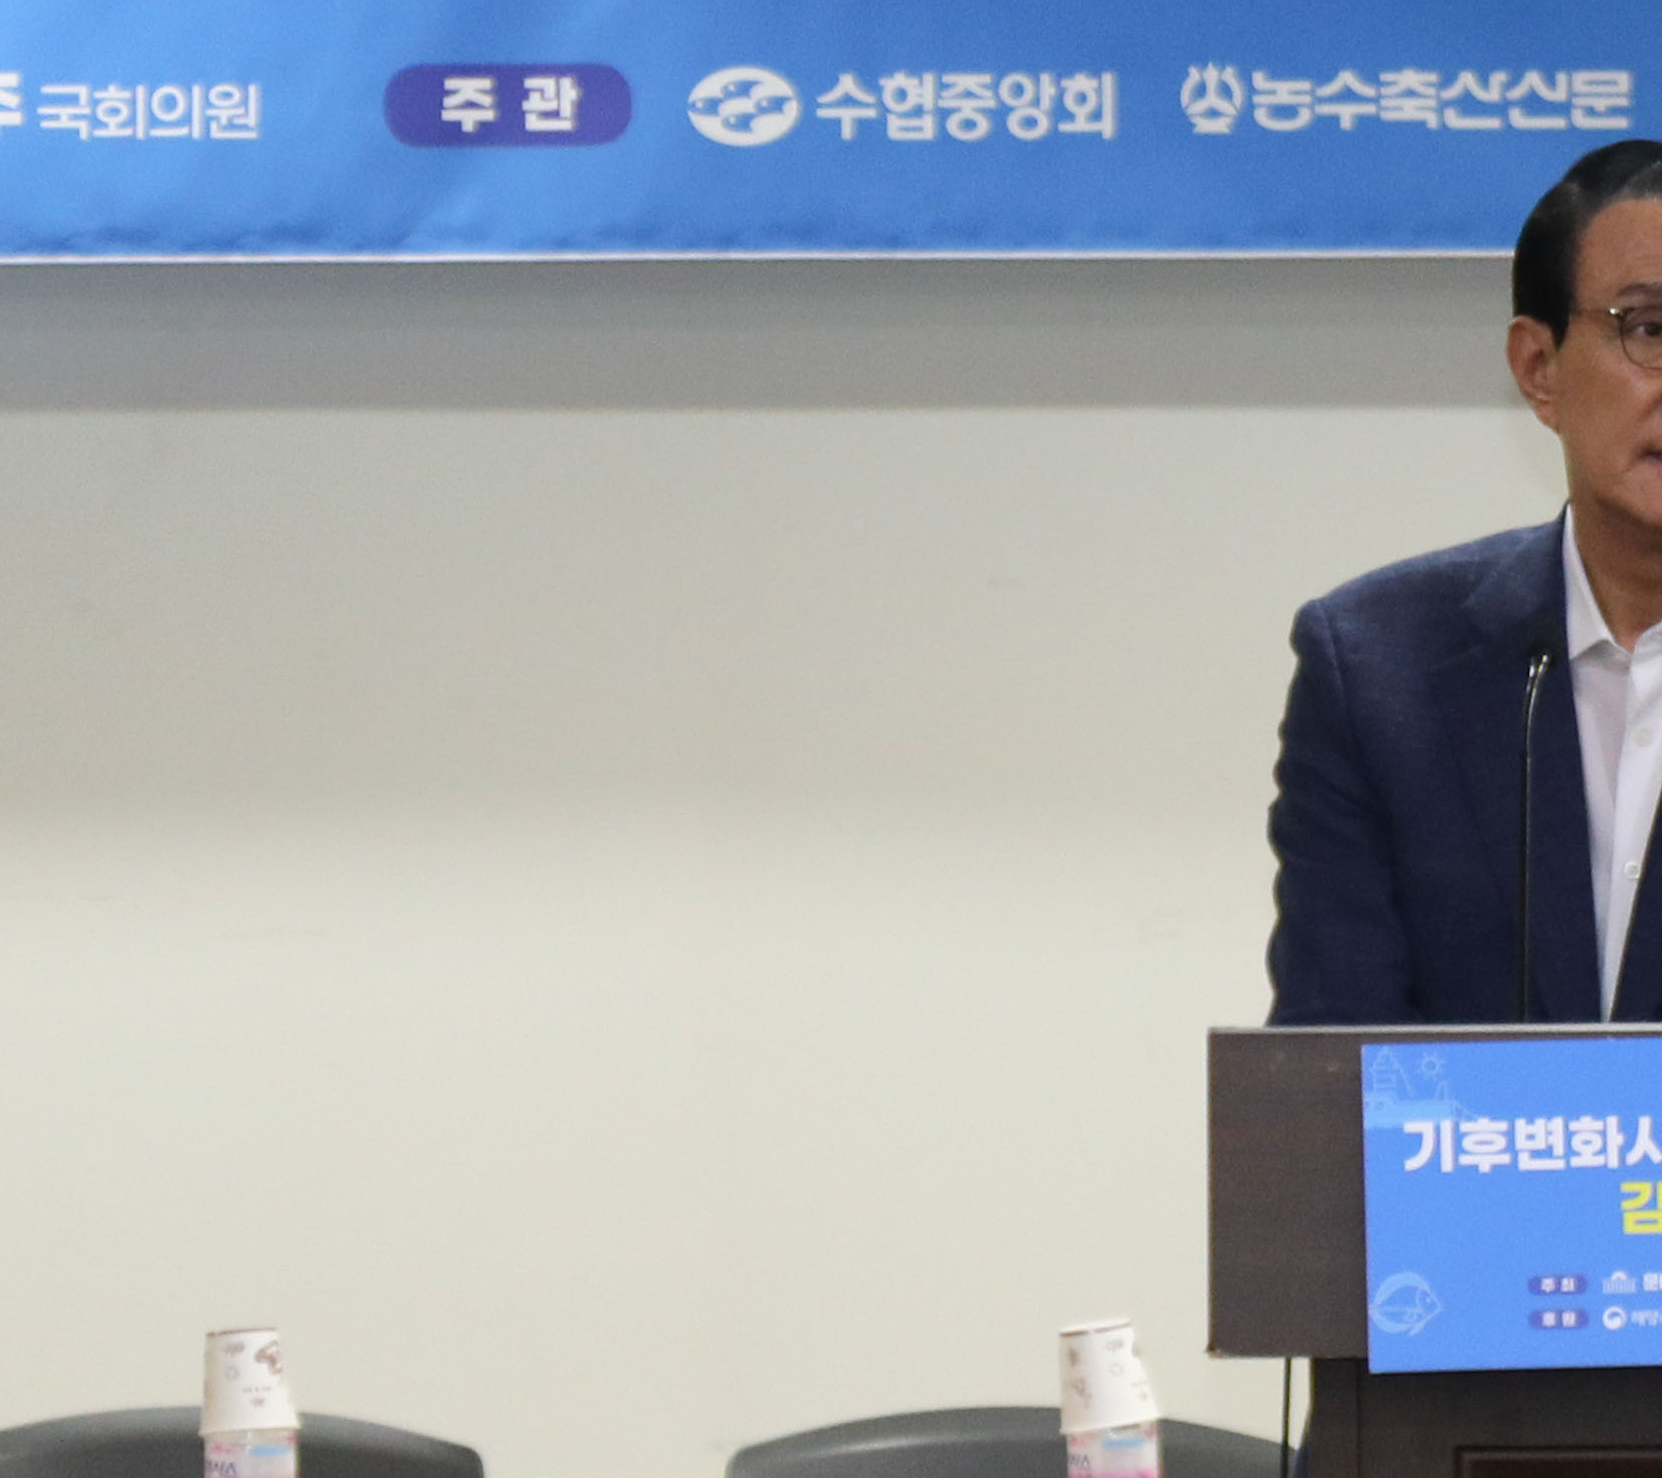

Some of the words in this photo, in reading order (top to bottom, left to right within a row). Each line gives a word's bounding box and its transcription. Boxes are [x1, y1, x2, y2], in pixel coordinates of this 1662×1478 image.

[36, 81, 261, 142] 국회의원
[814, 71, 1118, 142] 수협중앙회
[1249, 69, 1633, 132] 농수축산신문
